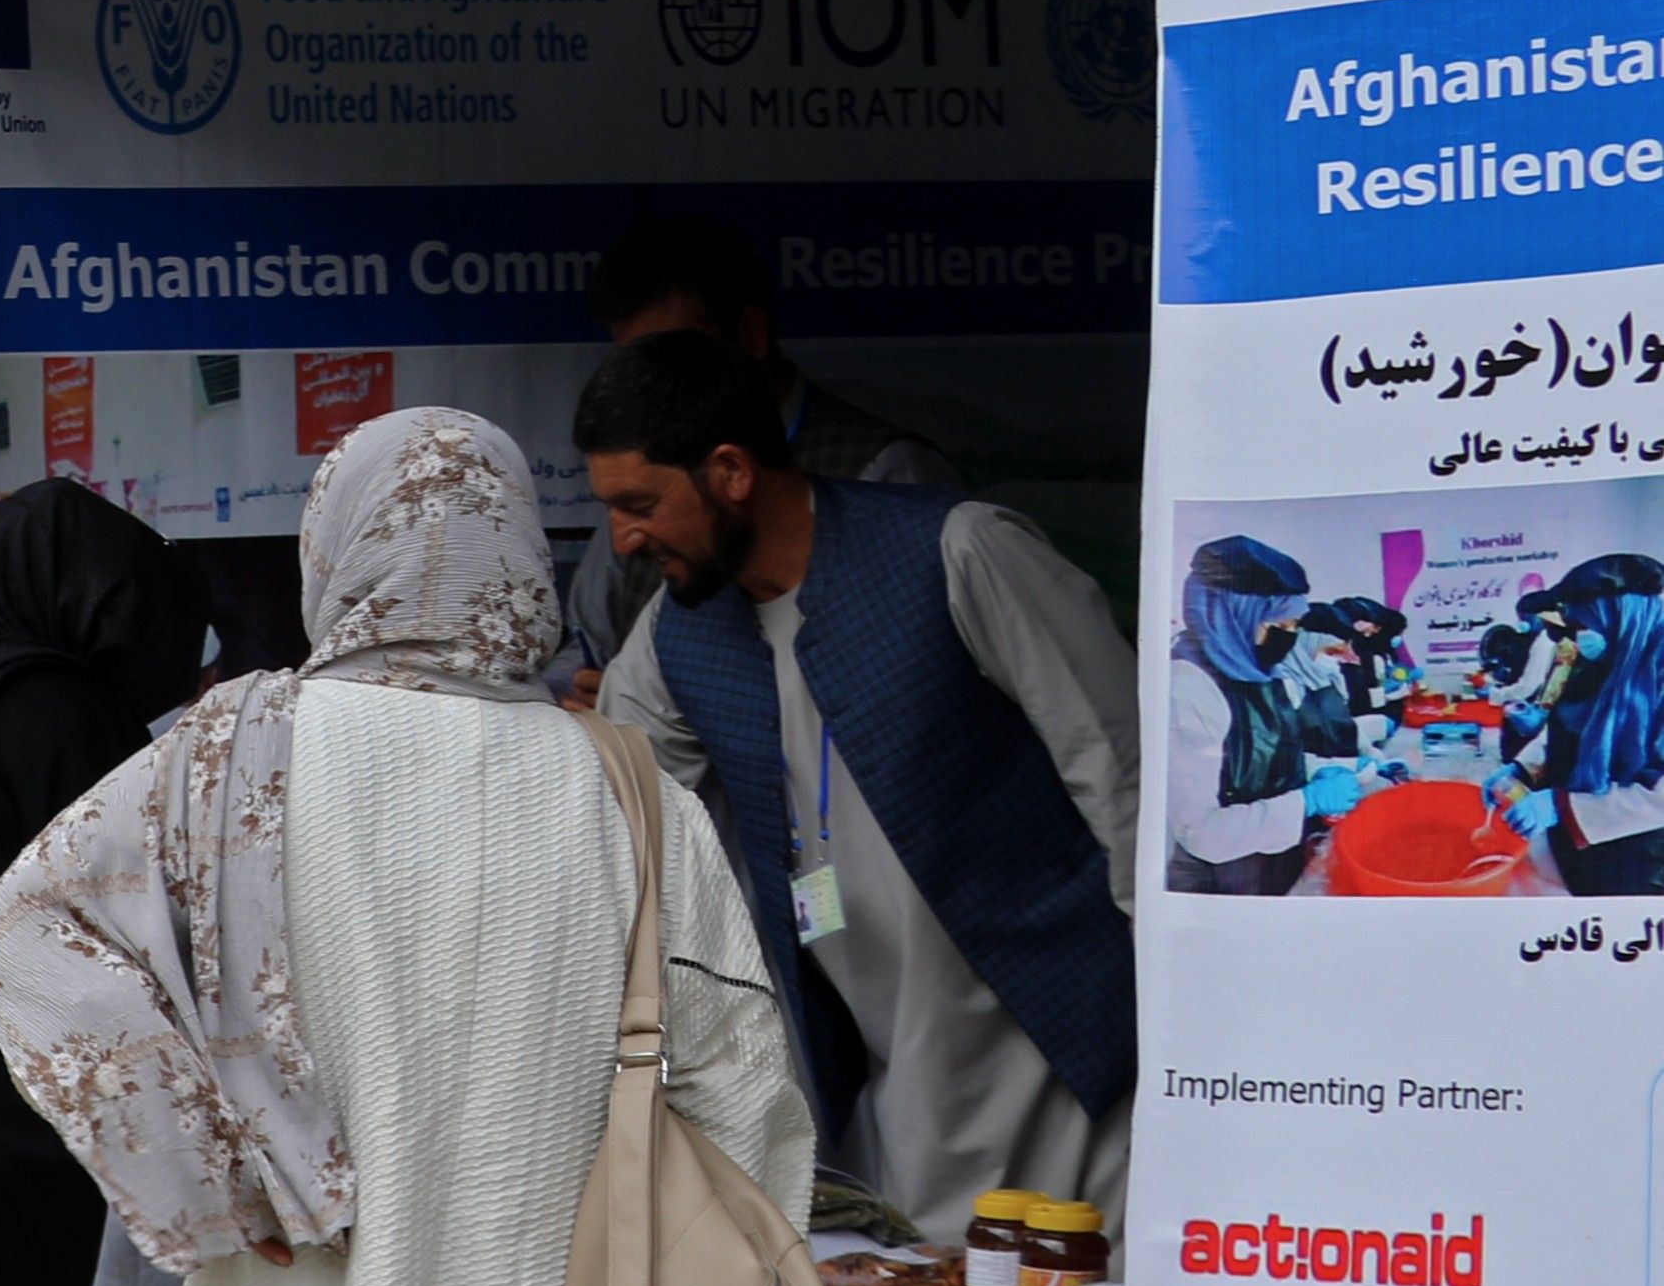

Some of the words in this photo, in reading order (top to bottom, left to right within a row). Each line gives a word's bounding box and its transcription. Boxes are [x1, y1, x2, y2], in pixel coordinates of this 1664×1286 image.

[264, 23, 483, 77] Organization
[494, 23, 529, 65] of
[535, 23, 590, 65] the
[267, 83, 379, 127] United
[391, 83, 518, 127] Nations
[660, 86, 725, 130] UN
[736, 86, 1006, 131] MIGRATION
[3, 240, 390, 316] Afghanistan
[1428, 430, 1503, 476] عالی
[1512, 421, 1600, 469] کیفیت
[1609, 422, 1630, 462] با
[1162, 1068, 1386, 1114] Implementing
[1398, 1078, 1525, 1111] Partner:
